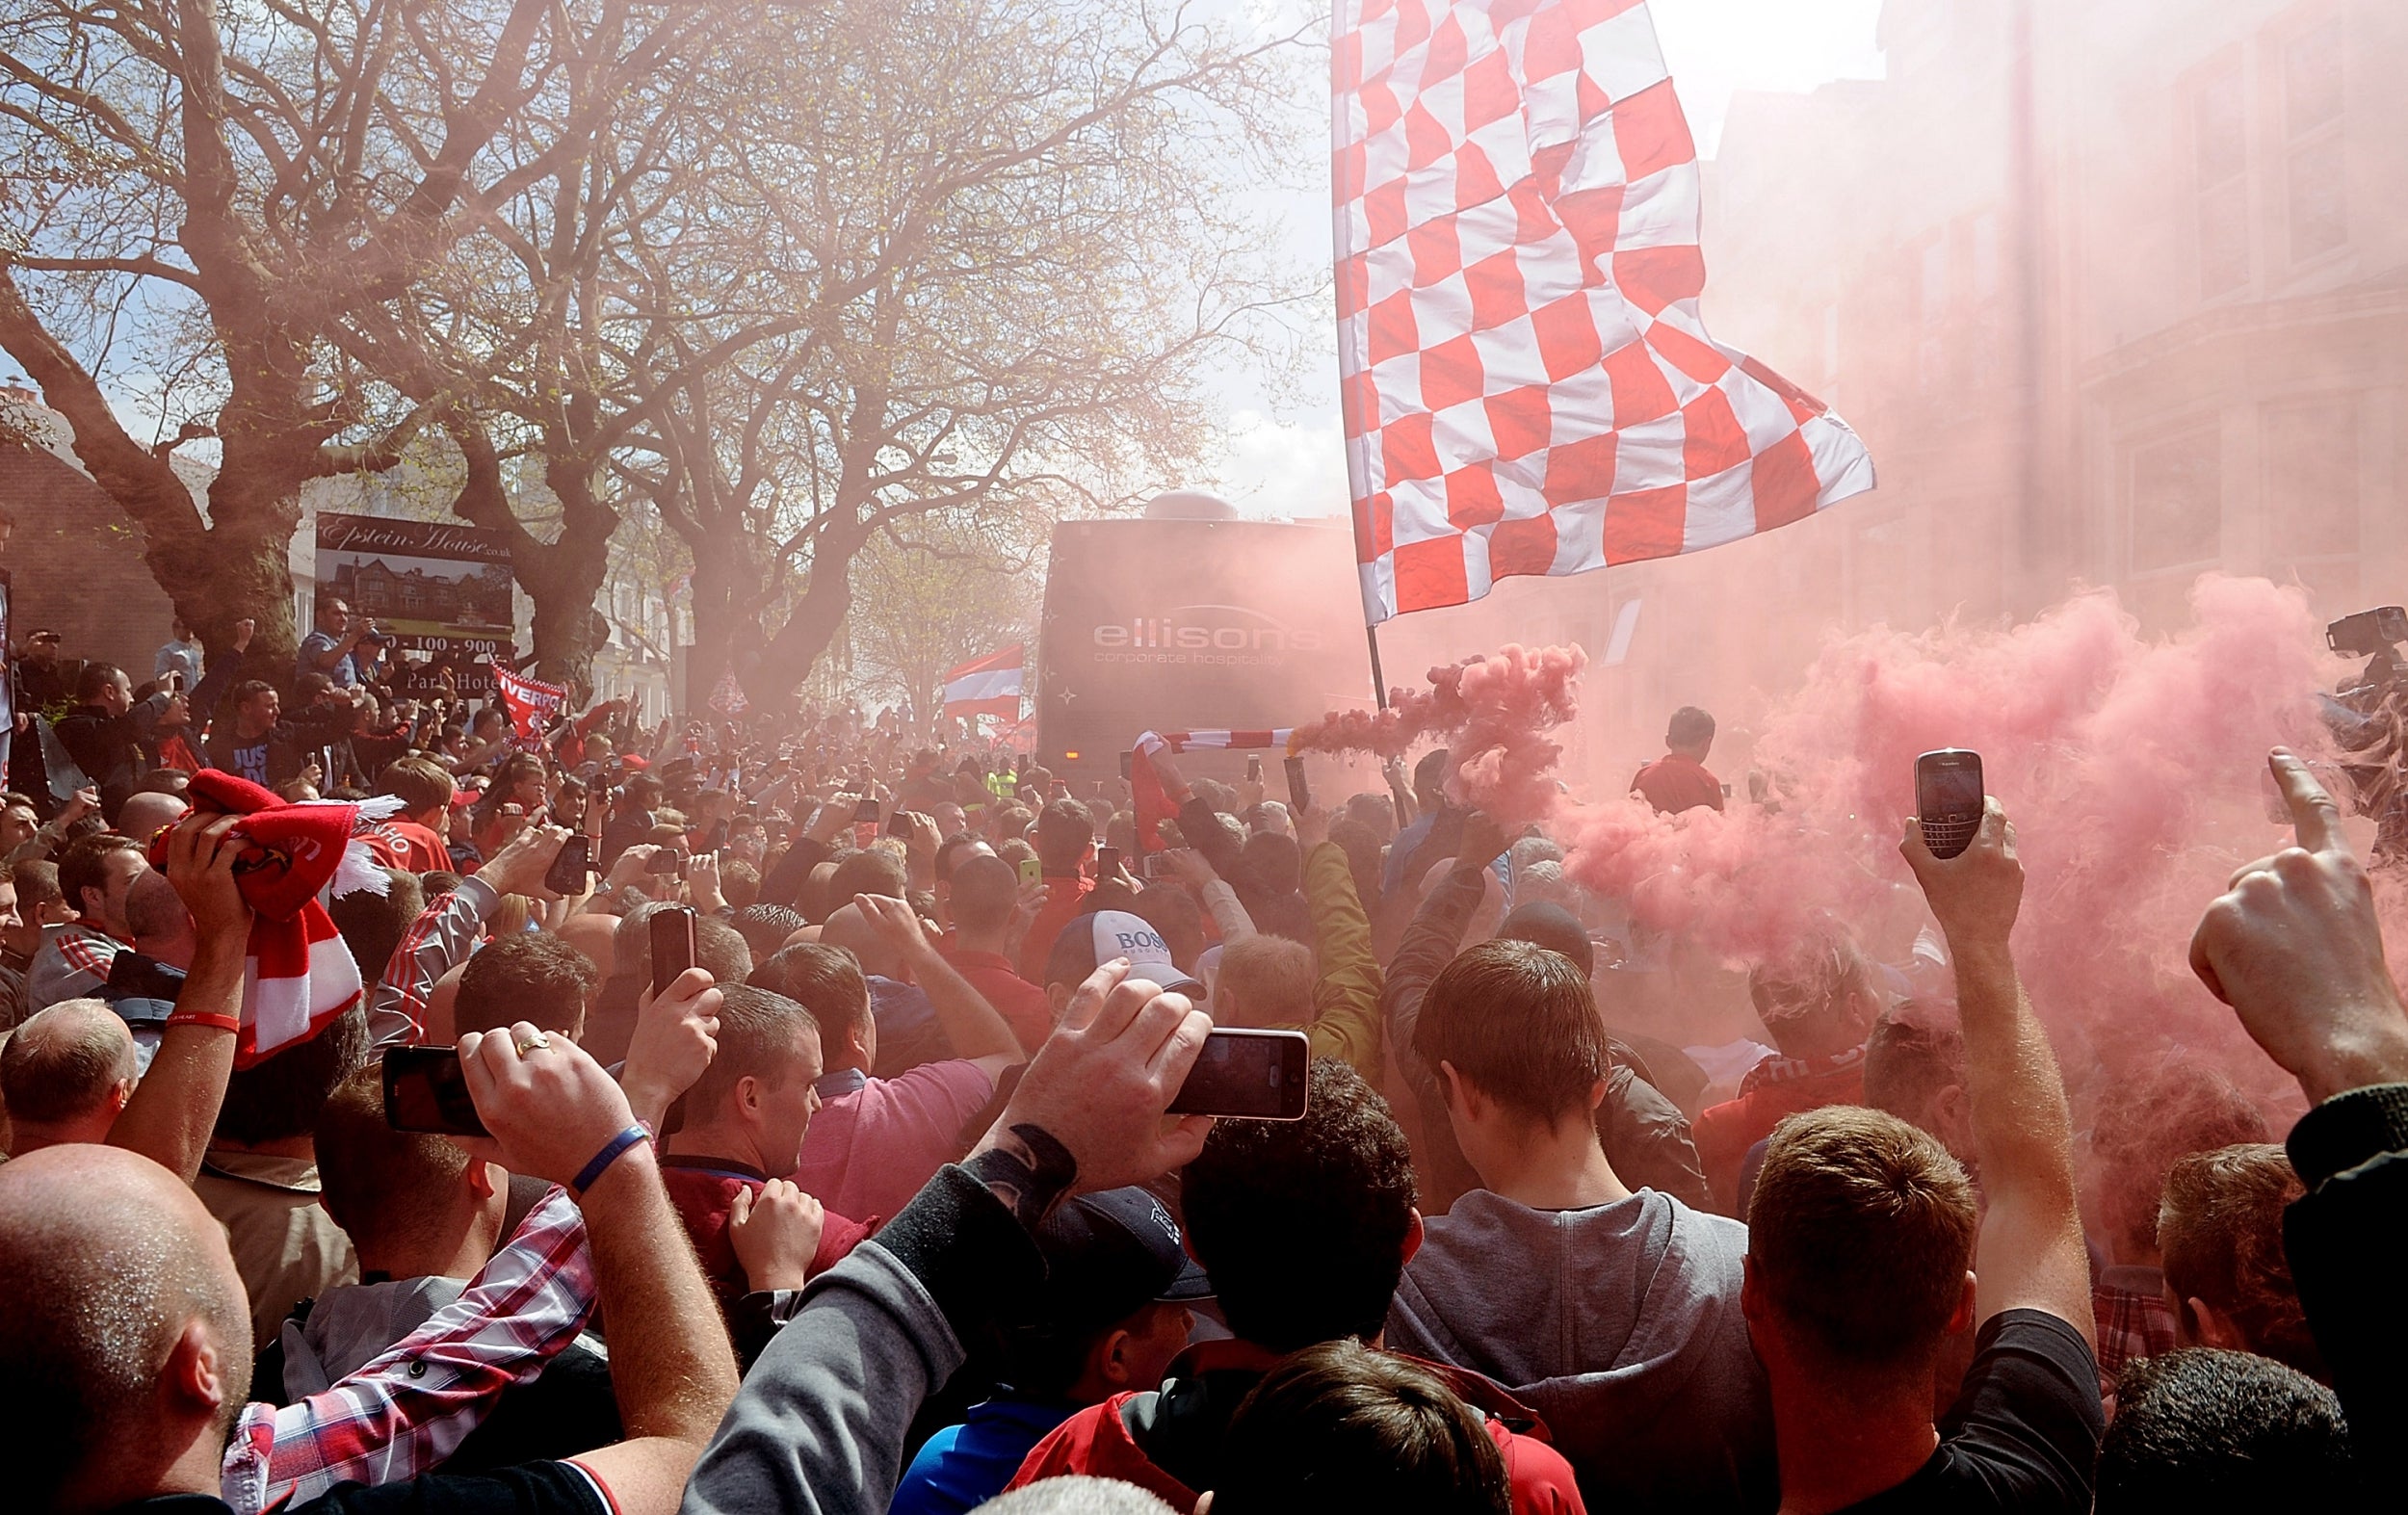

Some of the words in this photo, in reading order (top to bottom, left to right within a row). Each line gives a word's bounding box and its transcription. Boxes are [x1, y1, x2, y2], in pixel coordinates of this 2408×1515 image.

[319, 516, 408, 550] Epstein
[417, 636, 447, 651] 100
[464, 639, 496, 654] 900
[1093, 617, 1321, 649] ellisons
[1094, 651, 1187, 665] corporate
[1193, 651, 1285, 667] hospitality
[458, 675, 501, 691] Hote
[499, 675, 561, 709] IVERPO
[234, 744, 268, 770] JUS
